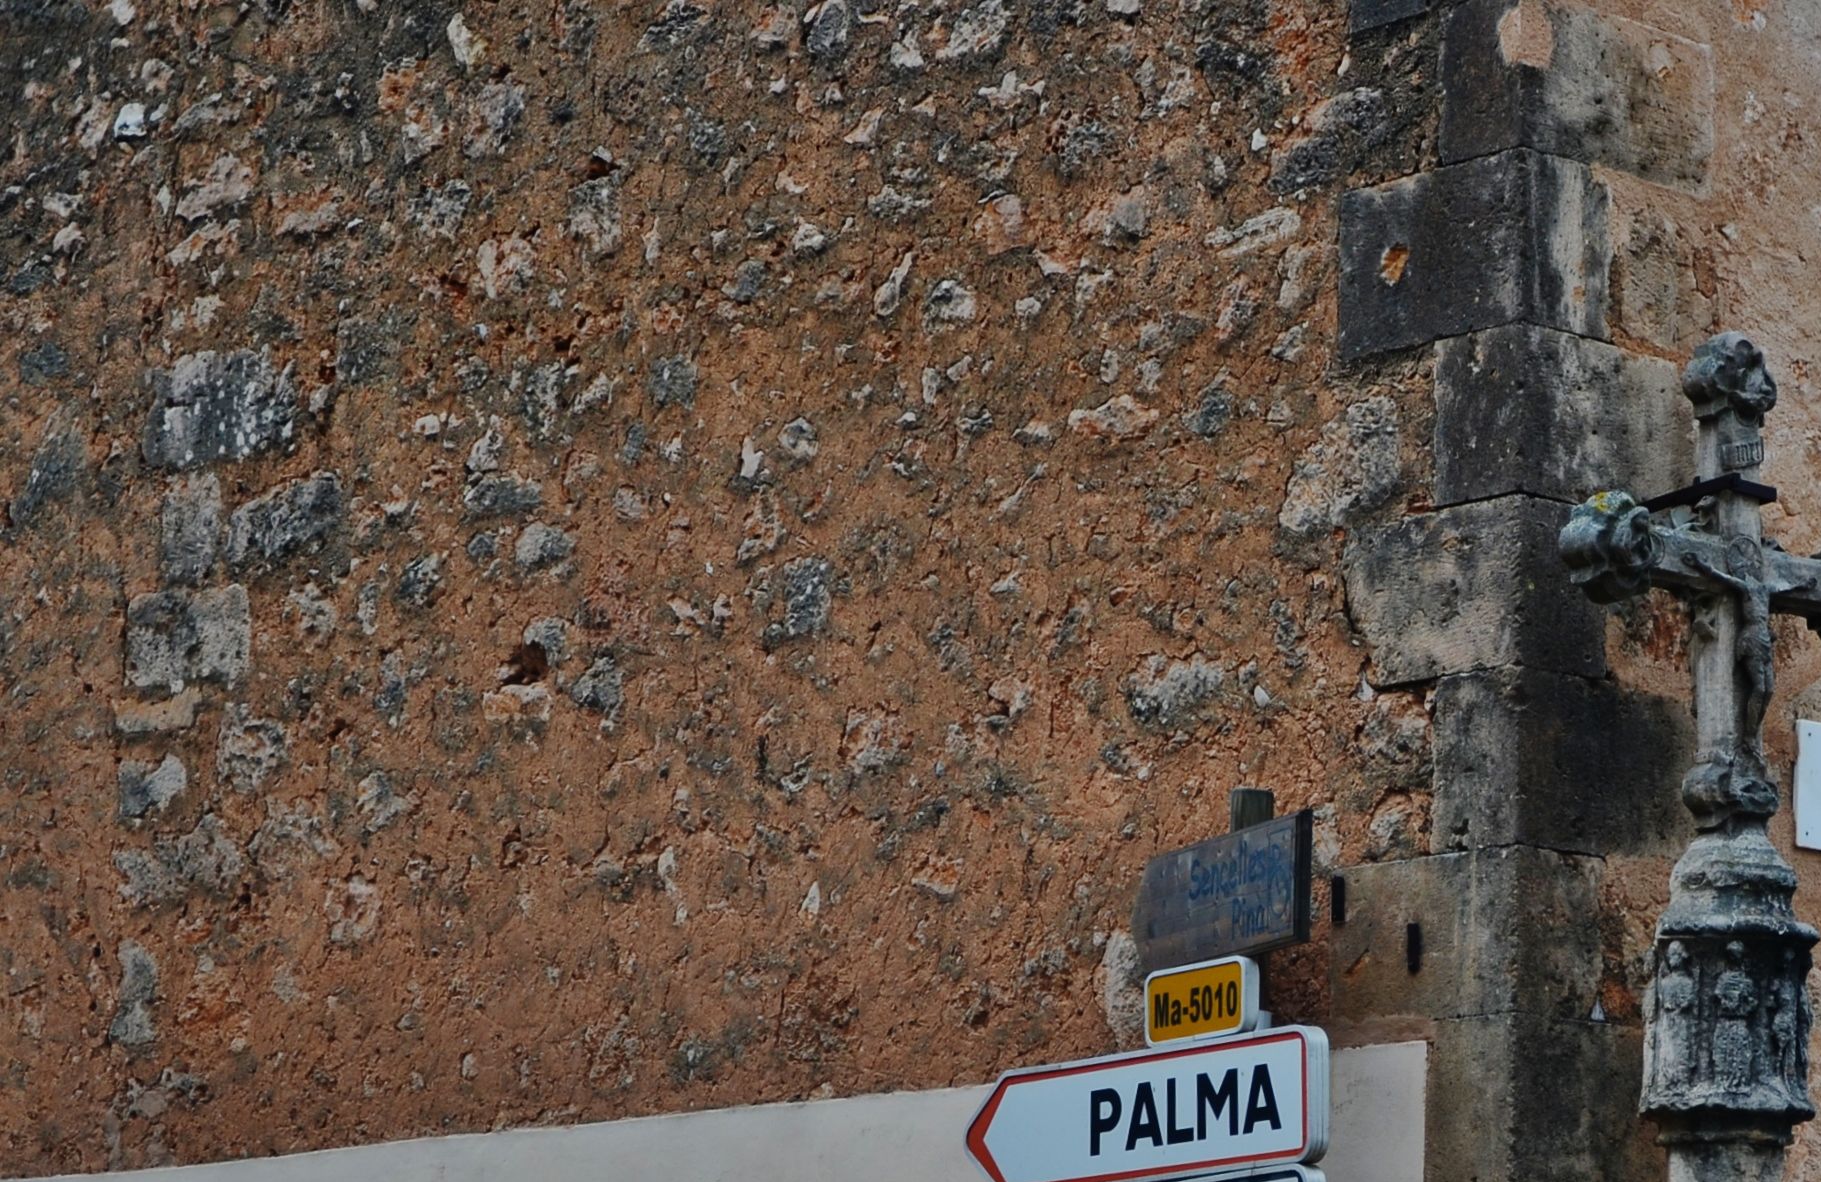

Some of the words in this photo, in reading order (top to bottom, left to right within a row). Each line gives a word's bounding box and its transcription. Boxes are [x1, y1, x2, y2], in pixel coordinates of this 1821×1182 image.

[1188, 838, 1266, 900] Sencelles
[1154, 980, 1238, 1029] Ma-5010
[1089, 1063, 1282, 1156] PALMA
